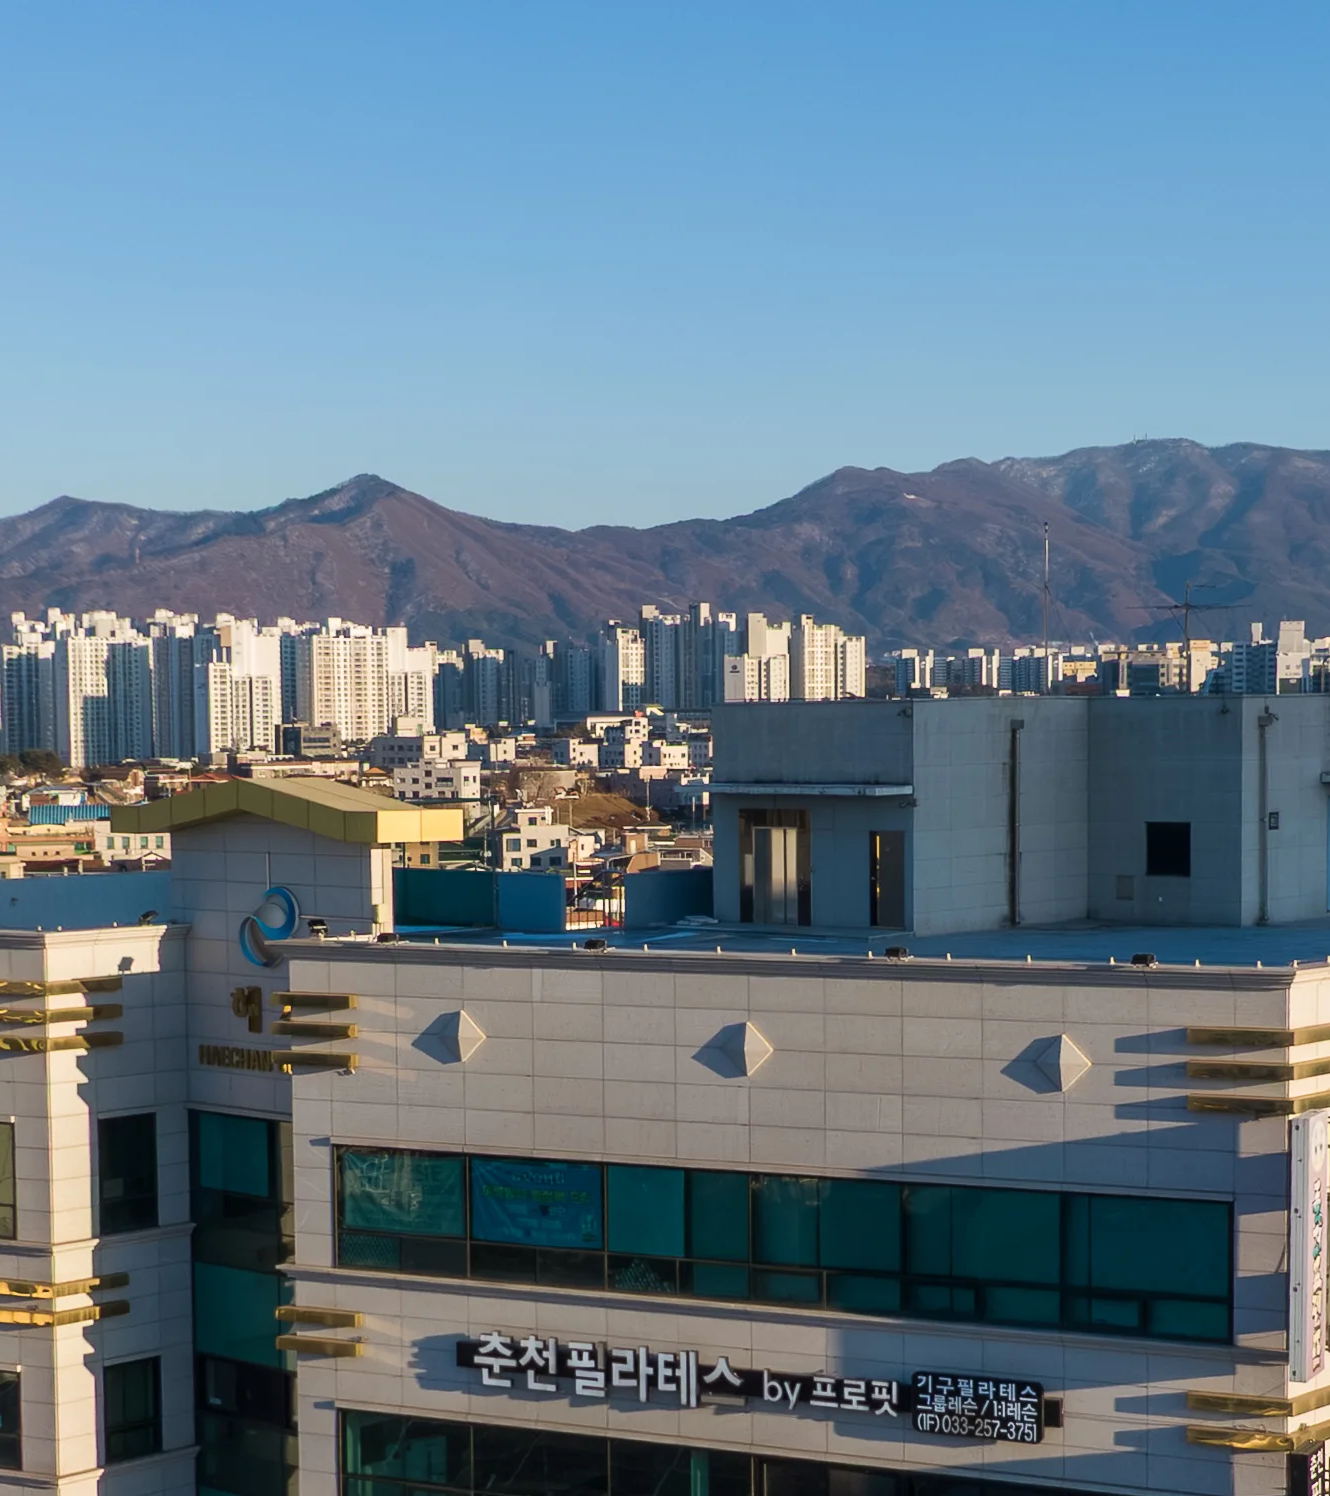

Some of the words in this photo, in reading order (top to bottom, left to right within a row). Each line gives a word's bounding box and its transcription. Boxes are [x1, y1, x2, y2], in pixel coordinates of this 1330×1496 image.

[473, 1331, 746, 1407] 춘천필라테스
[763, 1369, 801, 1411] by
[809, 1376, 899, 1418] 프로핏
